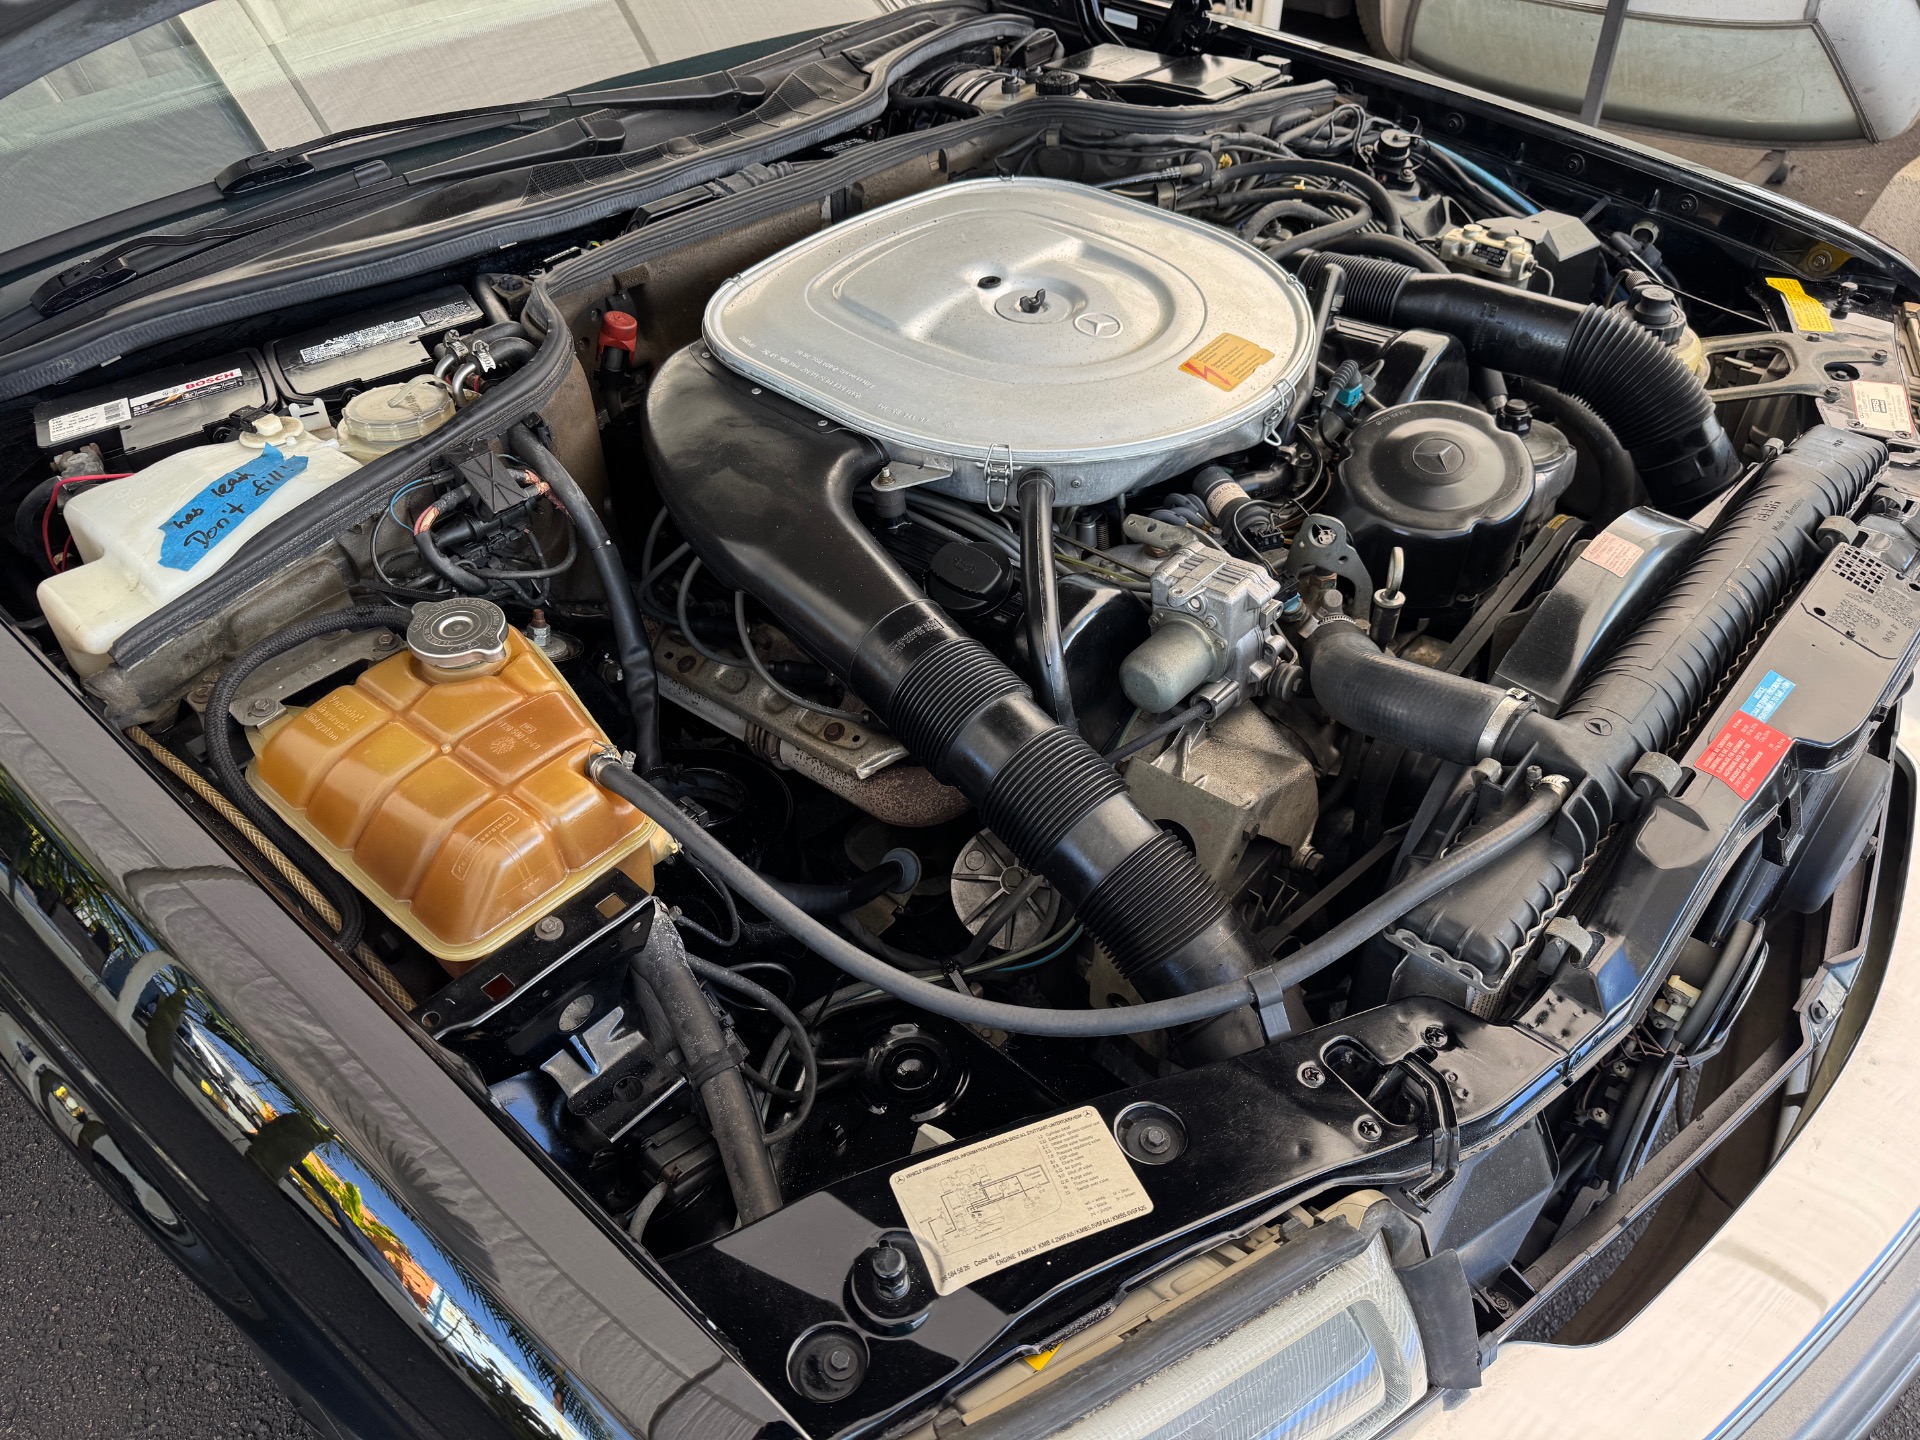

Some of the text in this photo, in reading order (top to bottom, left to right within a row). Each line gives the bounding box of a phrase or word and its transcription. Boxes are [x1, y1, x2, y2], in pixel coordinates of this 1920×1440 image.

[185, 371, 235, 391] BOSCH
[173, 472, 255, 529] has leak
[1772, 520, 1787, 533] Made
[1785, 498, 1805, 516] Germany
[184, 502, 245, 549] Don't
[329, 695, 364, 722] Vorsicht!
[1728, 760, 1746, 782] MERCEDES-BENZ
[1045, 1128, 1061, 1137] Cylinder
[1047, 1132, 1066, 1141] Electronic
[1065, 1127, 1080, 1135] ignition
[1062, 1133, 1079, 1141] manifold
[1053, 1142, 1068, 1150] Throttle
[1055, 1147, 1072, 1156] Pressure
[1072, 1141, 1091, 1151] regulating
[904, 1168, 922, 1178] VEHICLE
[921, 1161, 942, 1172] EMISSION
[940, 1154, 960, 1165] CONTROL
[959, 1145, 987, 1158] INFORMATION
[985, 1134, 1020, 1149] MERCEDES-BENZ
[1070, 1173, 1082, 1182] Purge
[1081, 1169, 1093, 1177] valve
[1086, 1174, 1099, 1182] valve
[1076, 1183, 1091, 1192] Switch
[1123, 1190, 1136, 1198] brown
[1099, 1205, 1112, 1213] purple
[994, 1252, 1016, 1266] ENGINE
[1016, 1244, 1037, 1257] FAMILY
[1037, 1239, 1051, 1249] KMB
[972, 1255, 988, 1266] Code
